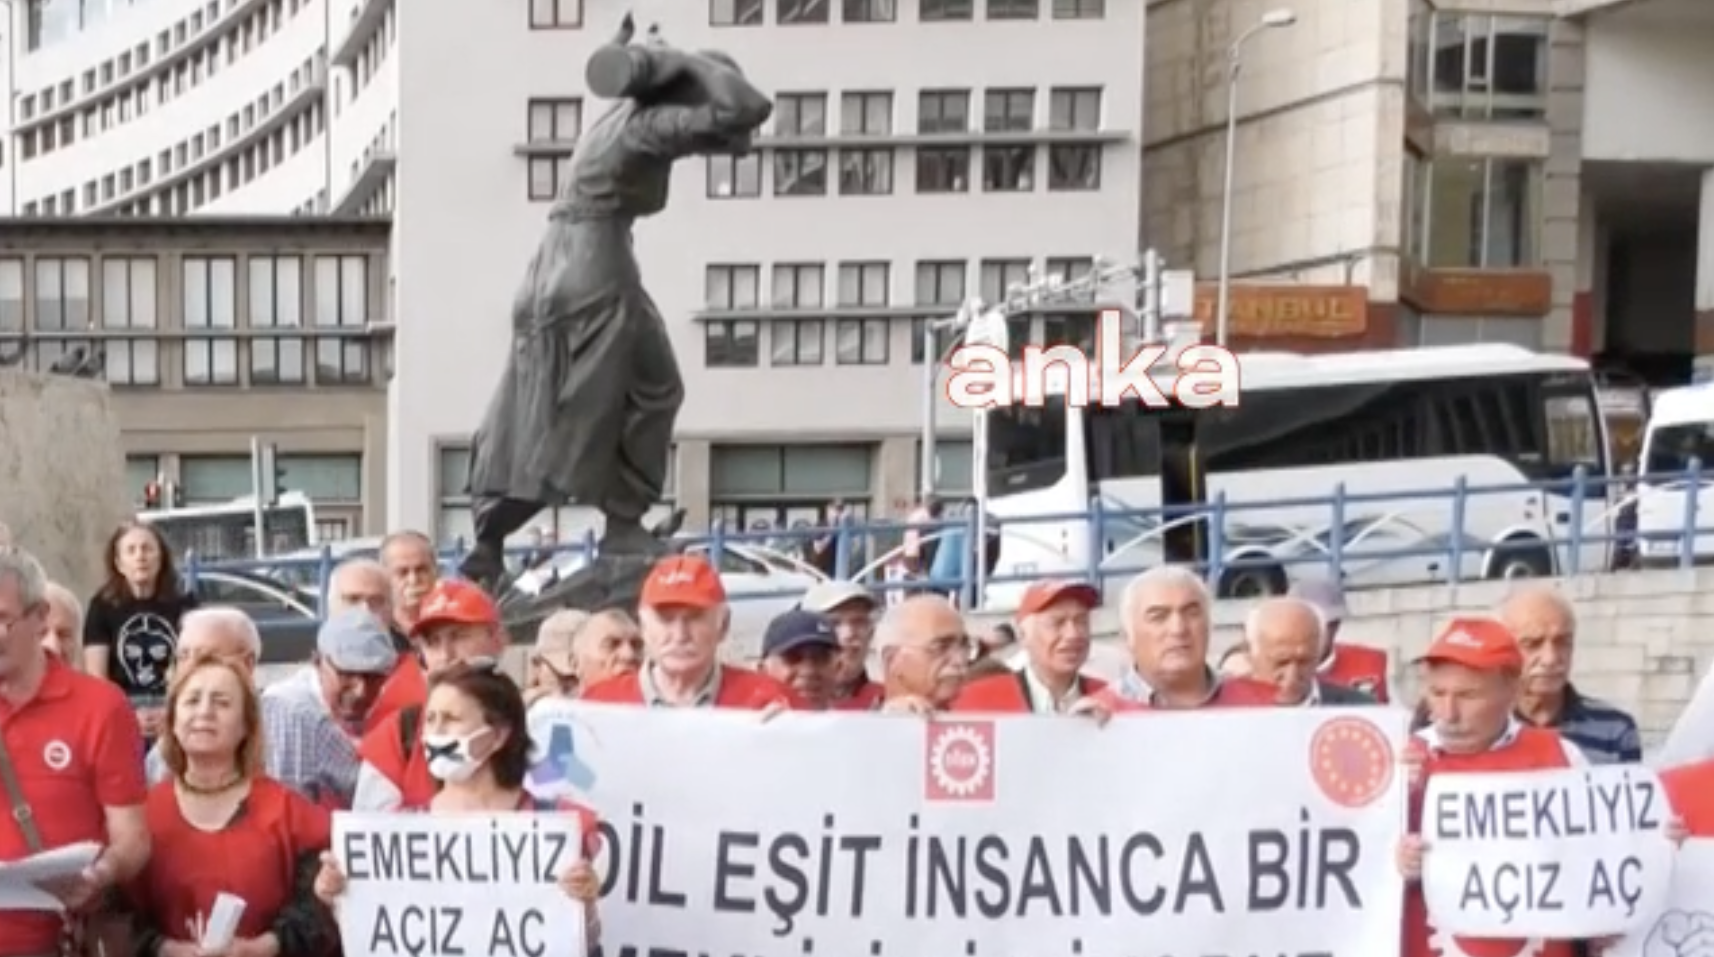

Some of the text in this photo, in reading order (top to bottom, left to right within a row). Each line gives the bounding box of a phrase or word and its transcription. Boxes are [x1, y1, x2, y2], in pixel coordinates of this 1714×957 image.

[1193, 295, 1350, 322] TANBUL
[1437, 771, 1658, 839] EMEKLİYİZ
[344, 818, 567, 884] EMEKLİYİZ
[714, 813, 882, 937] EŞİT
[906, 814, 1225, 919] İNSANCA
[1247, 806, 1362, 912] BİR
[1459, 855, 1642, 923] AÇIZ AÇ
